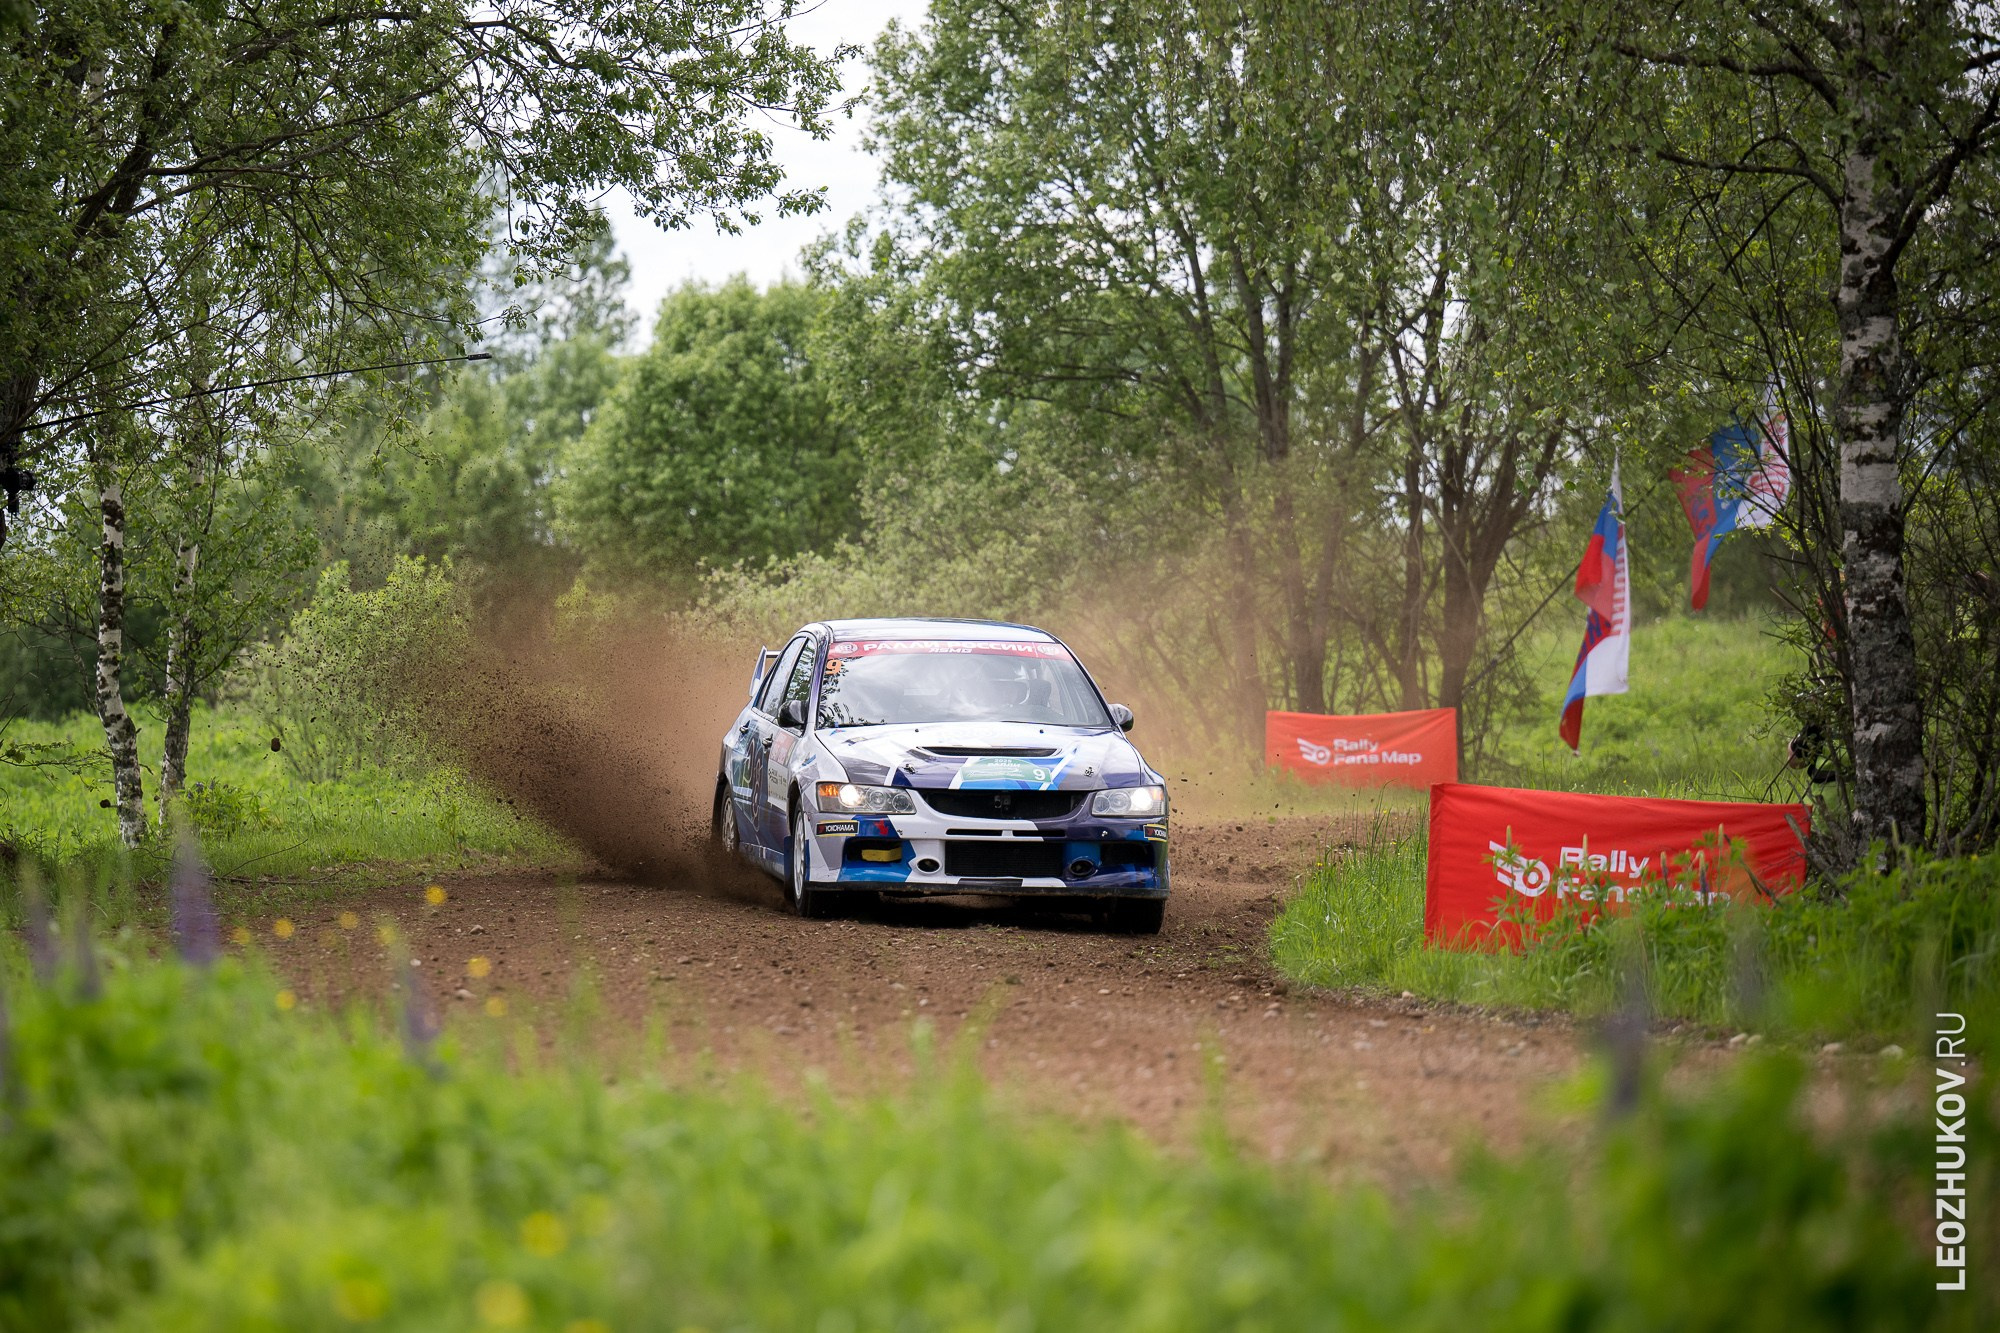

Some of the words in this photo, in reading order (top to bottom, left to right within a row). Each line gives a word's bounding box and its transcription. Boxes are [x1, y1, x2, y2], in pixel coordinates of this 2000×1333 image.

[863, 641, 938, 651] РАЛЛИ
[946, 641, 1033, 654] РОССИИ
[826, 659, 842, 675] 9
[1333, 738, 1378, 752] Rally
[1333, 753, 1379, 765] Fans
[1381, 751, 1422, 766] Map
[1033, 768, 1046, 781] 9
[825, 824, 855, 832] YOKOHAMA
[1560, 846, 1650, 879] Rally
